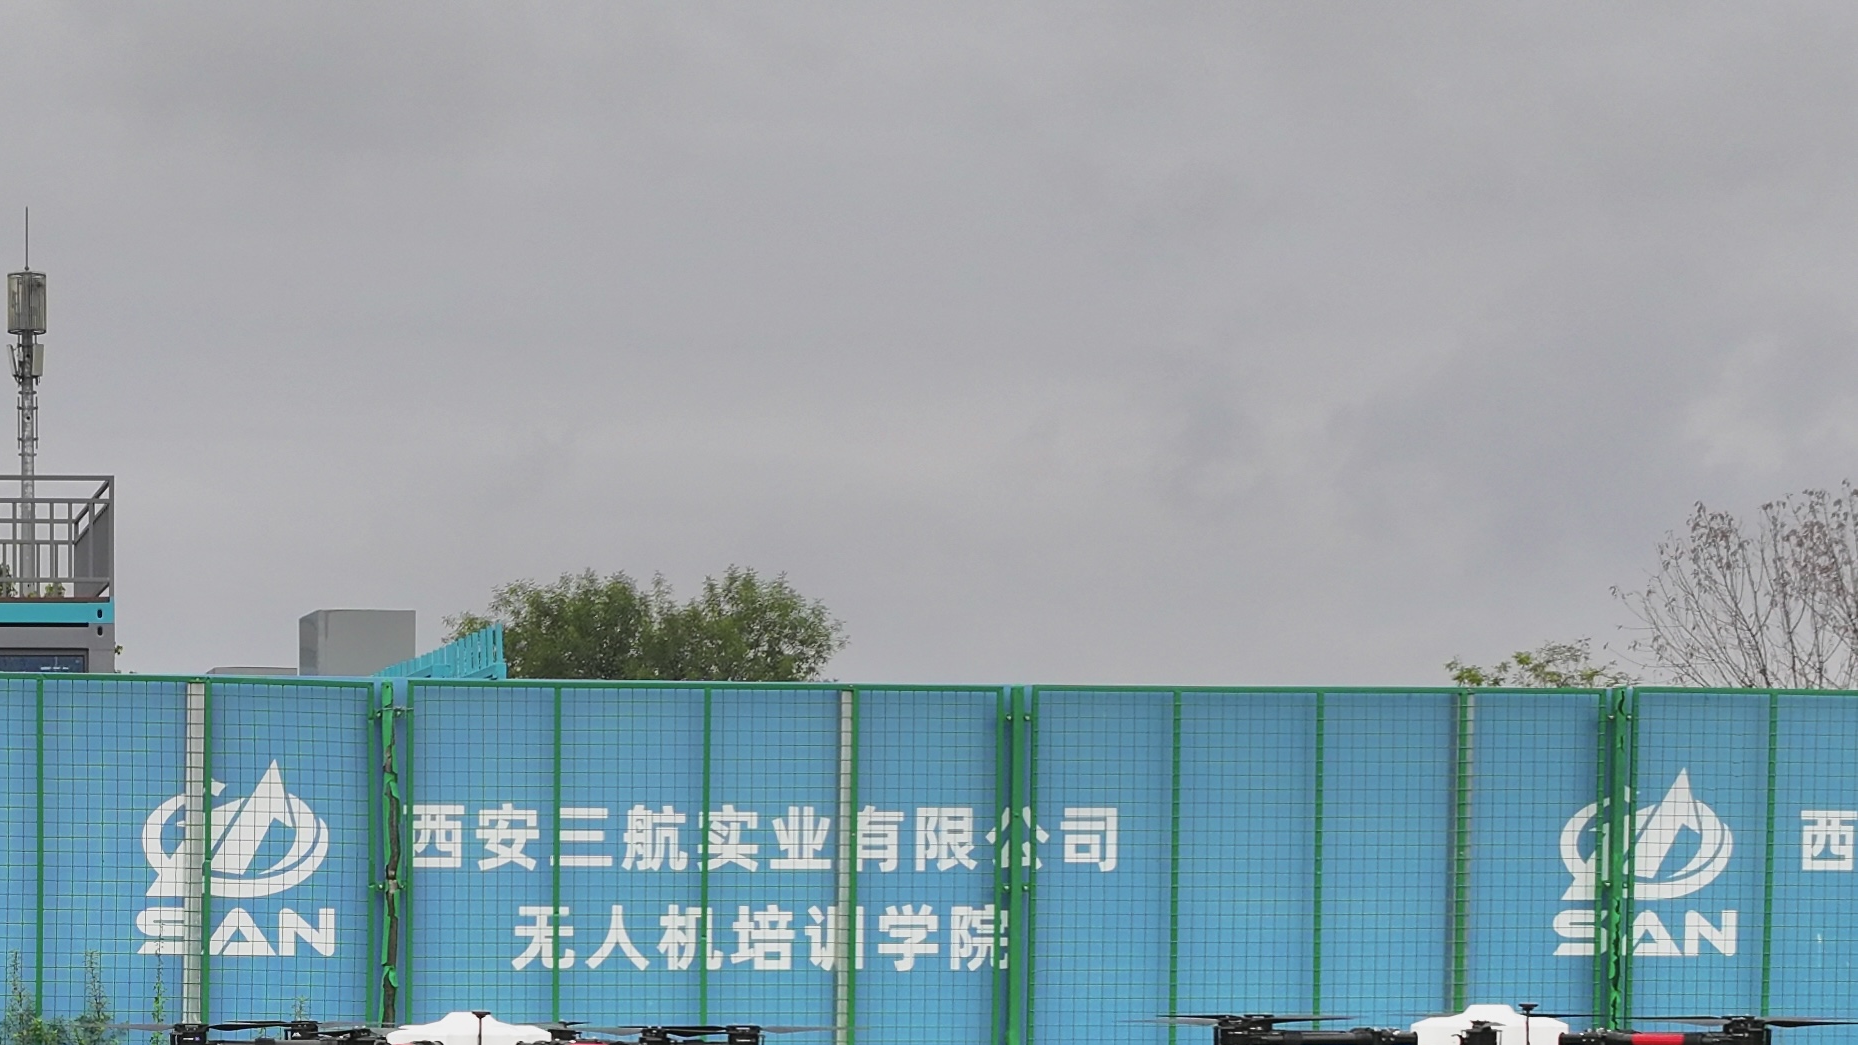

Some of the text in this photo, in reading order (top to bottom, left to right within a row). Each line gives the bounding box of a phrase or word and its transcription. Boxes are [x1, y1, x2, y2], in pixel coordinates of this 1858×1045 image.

[1801, 810, 1858, 871] 西
[136, 907, 335, 957] SAN
[512, 904, 1010, 972] 无人机培训学院
[1552, 909, 1738, 957] SAN
